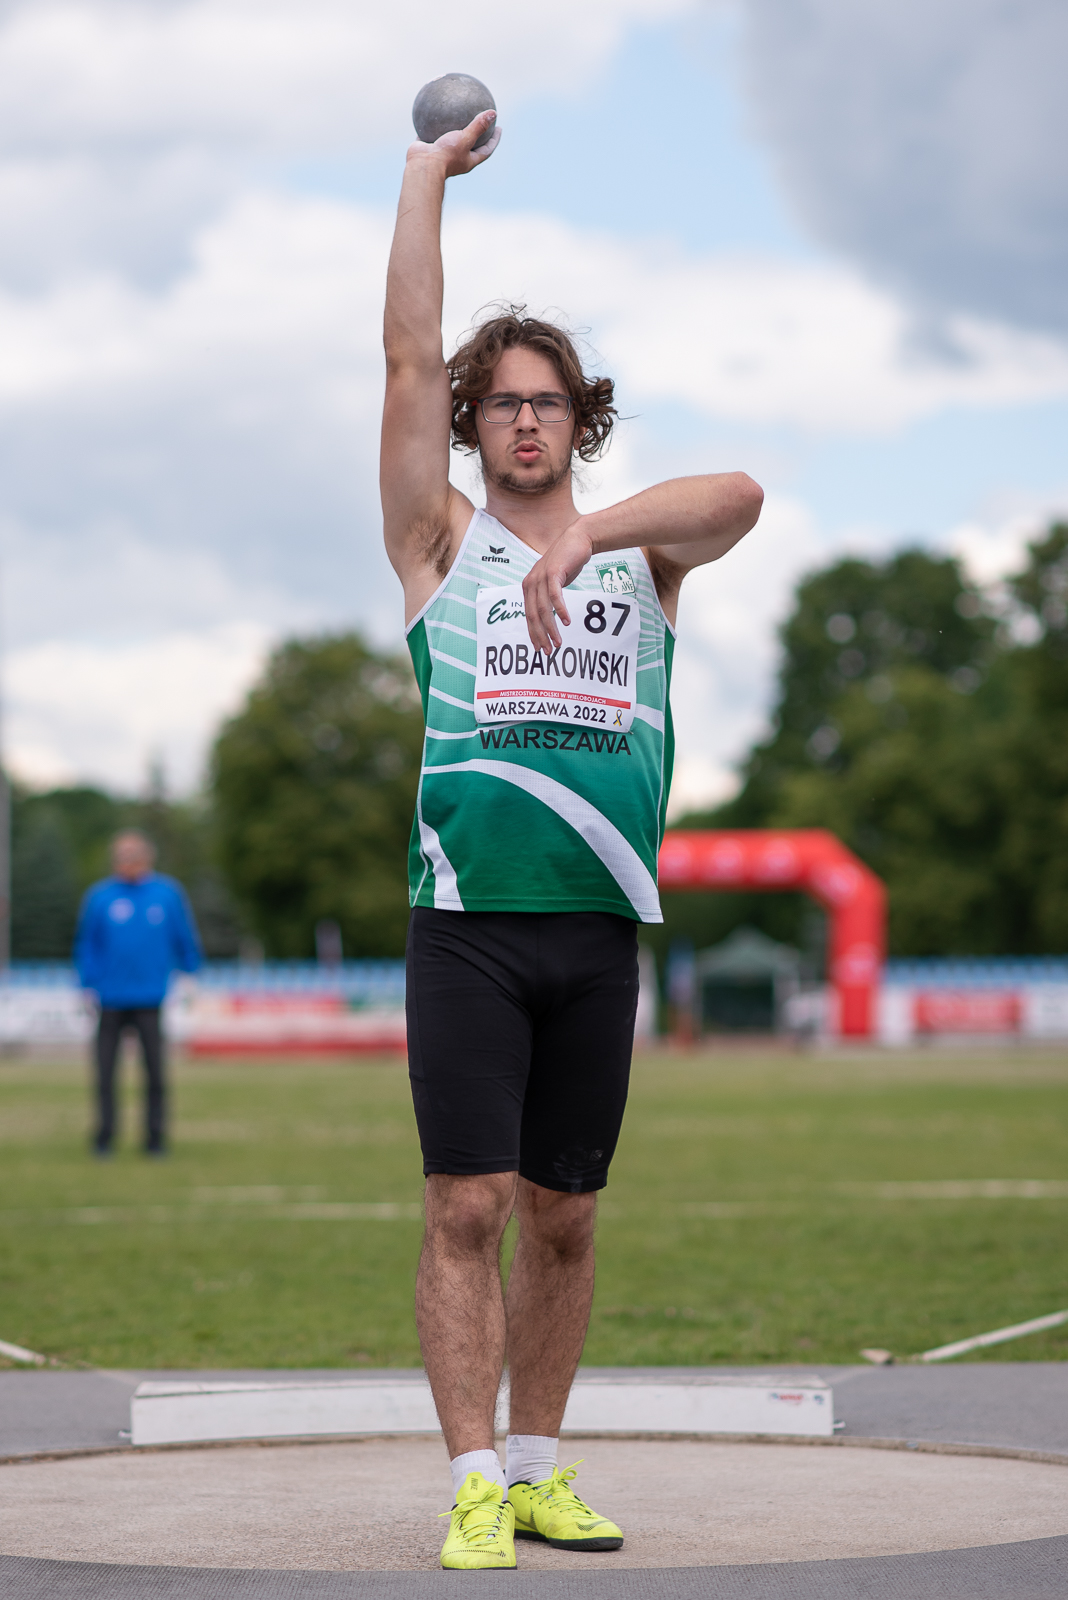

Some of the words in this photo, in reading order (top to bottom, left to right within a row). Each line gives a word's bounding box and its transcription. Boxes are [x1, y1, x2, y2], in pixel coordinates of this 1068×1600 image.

[481, 555, 510, 563] erima
[595, 560, 627, 569] WARSZAWA
[584, 599, 631, 637] 87
[485, 644, 629, 687] ROBAKOWSKI
[567, 693, 607, 704] WIELOBOJACH
[486, 701, 569, 717] WARSZAWA
[573, 705, 606, 723] 2022
[479, 728, 632, 756] WARSZAWA
